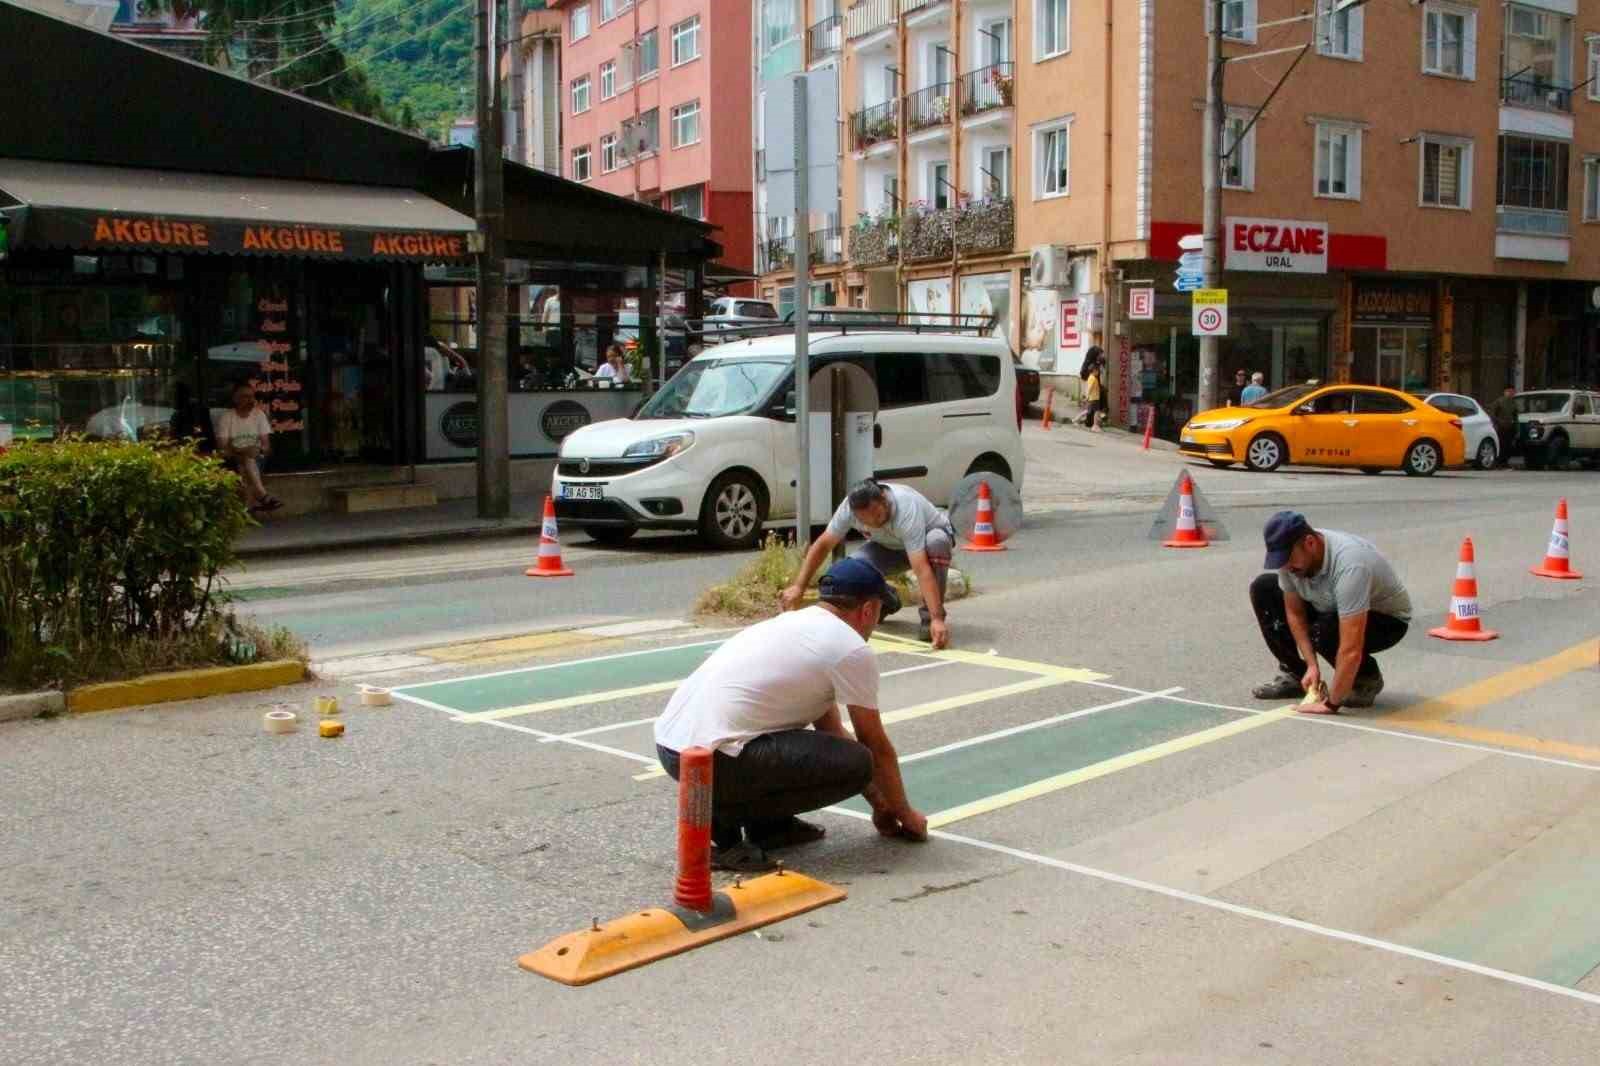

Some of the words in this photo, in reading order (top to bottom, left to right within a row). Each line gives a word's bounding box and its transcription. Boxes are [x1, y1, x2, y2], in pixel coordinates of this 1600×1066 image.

[94, 216, 209, 246] AKGÜRE
[242, 224, 344, 252] AKGÜRE
[372, 231, 462, 256] AKGÜRE
[1234, 223, 1325, 255] ECZANE
[1266, 255, 1292, 268] URAL
[1135, 295, 1146, 312] E
[1064, 308, 1078, 340] E
[1204, 314, 1216, 325] 30
[576, 487, 588, 497] AG
